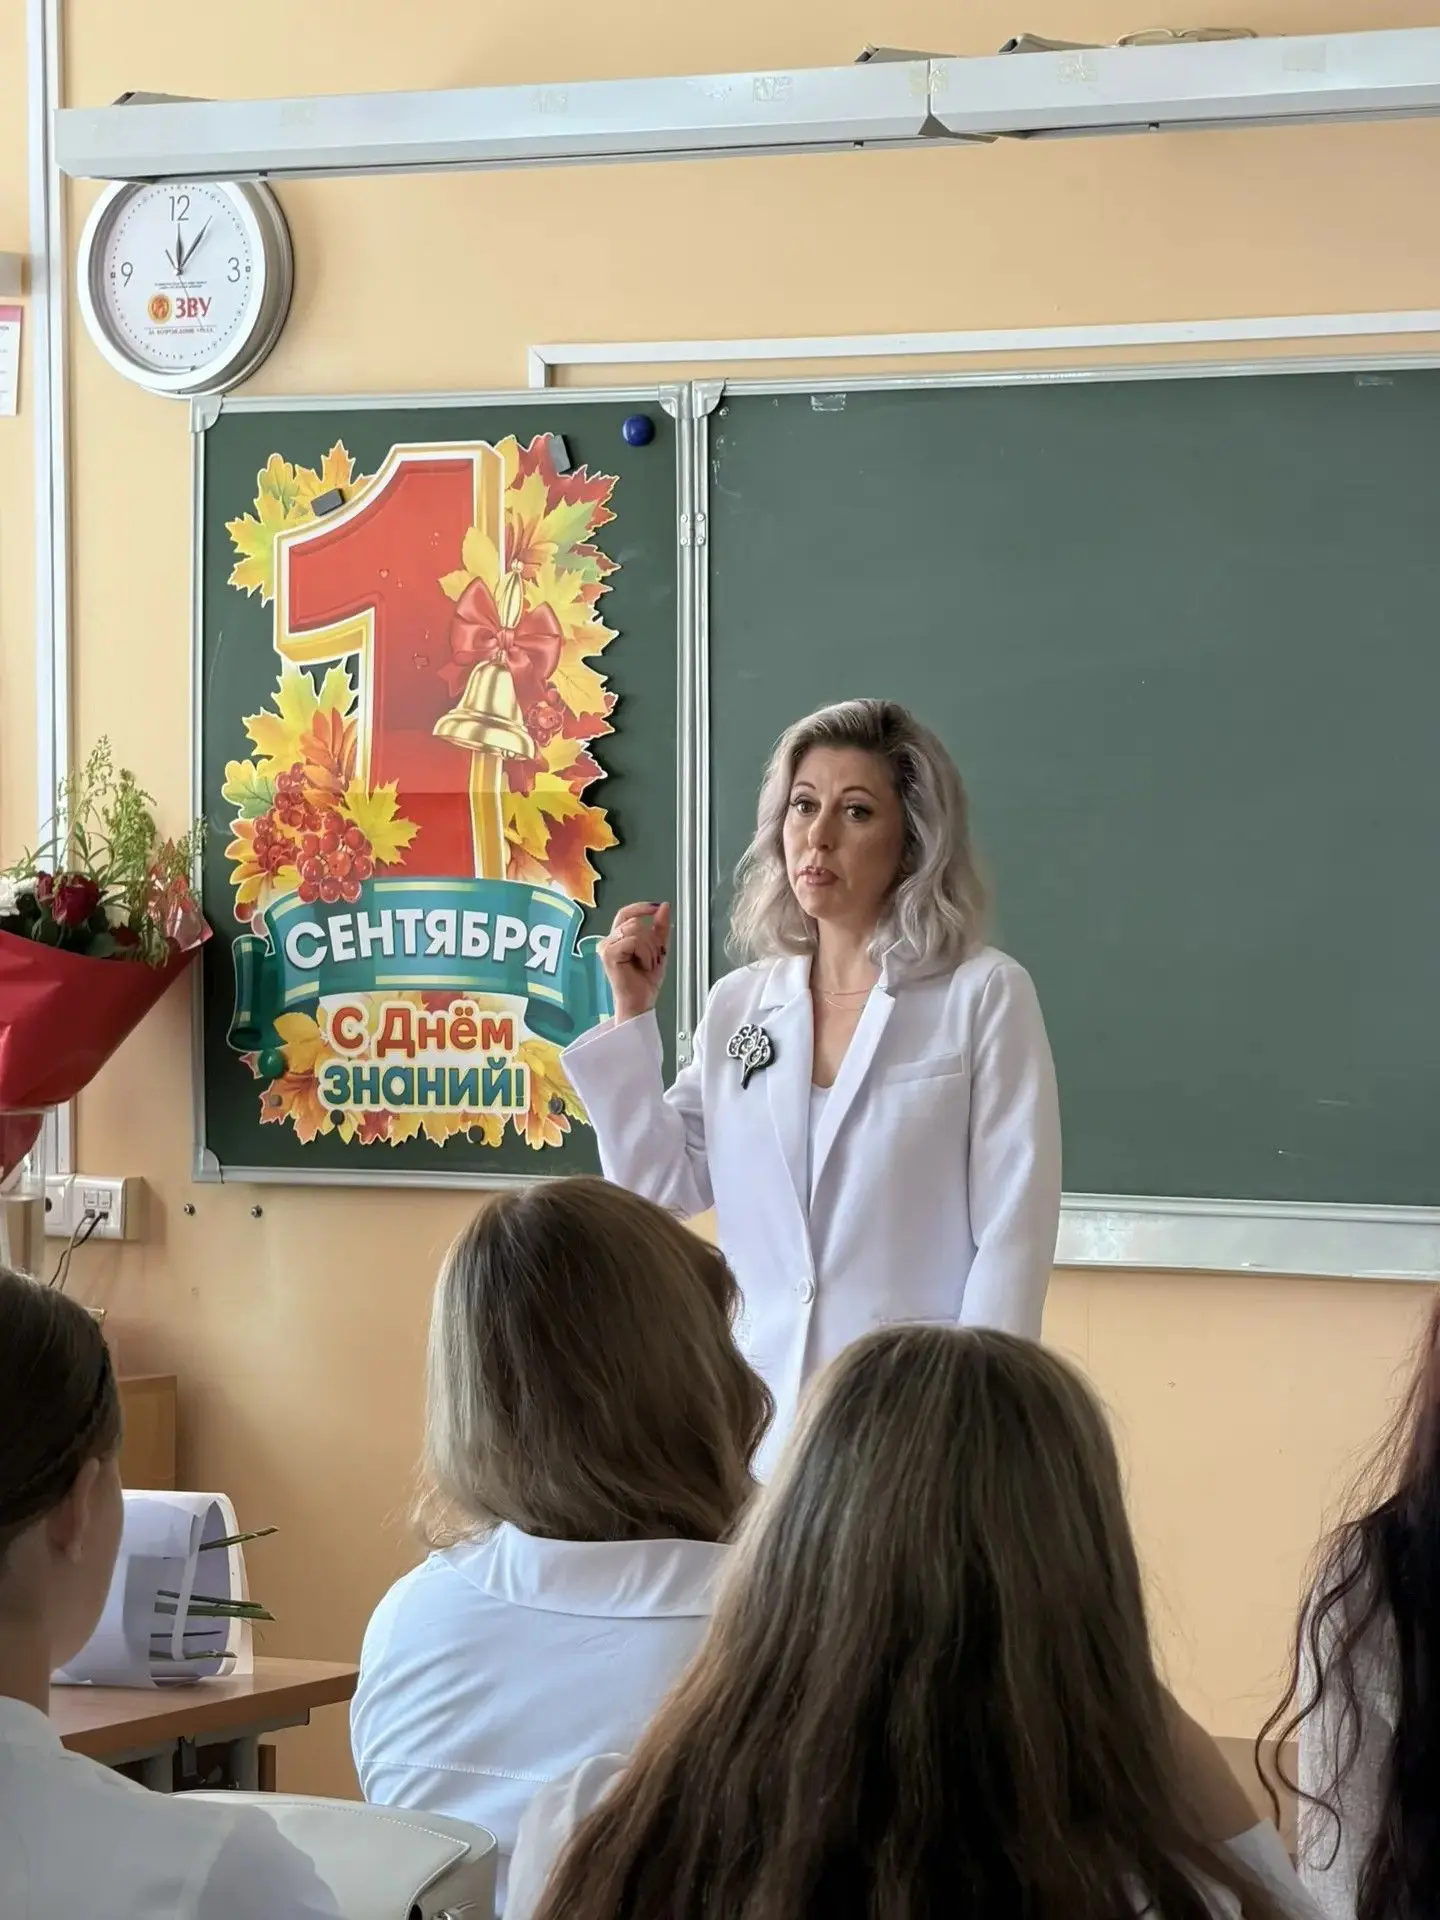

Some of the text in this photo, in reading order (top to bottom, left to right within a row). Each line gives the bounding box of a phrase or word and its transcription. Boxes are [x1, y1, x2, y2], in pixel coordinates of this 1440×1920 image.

[169, 195, 190, 221] 12
[121, 261, 134, 288] 9
[227, 257, 241, 283] 3
[175, 296, 212, 319] ЗВУ
[274, 441, 504, 878] 1
[285, 908, 564, 975] СЕНТЯБРЯ
[331, 1006, 514, 1058] С Днём
